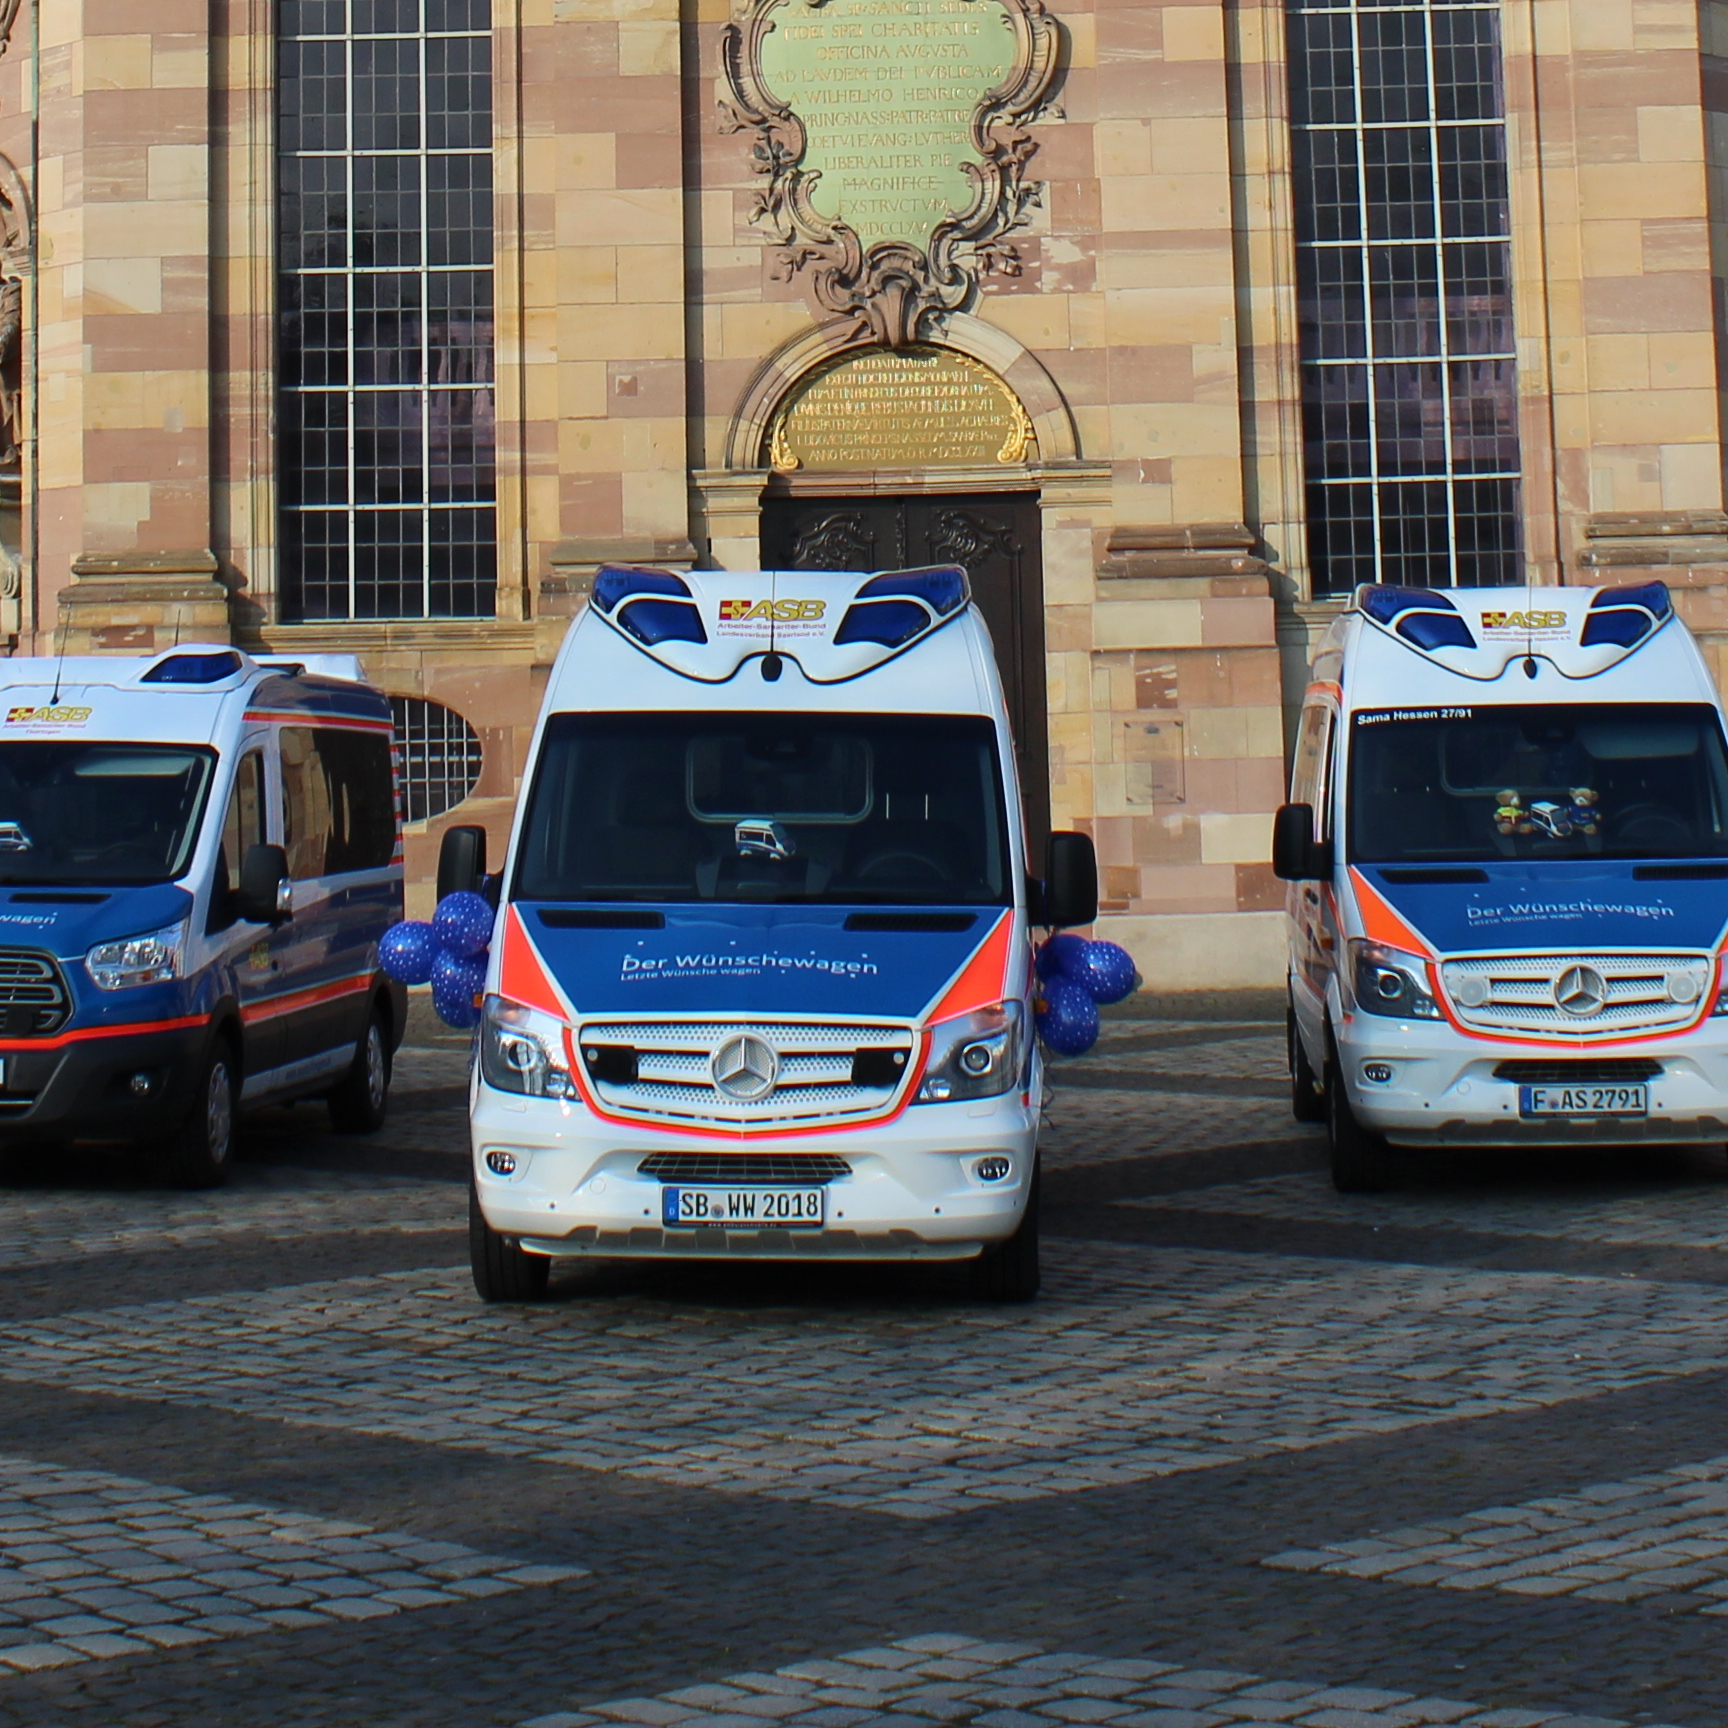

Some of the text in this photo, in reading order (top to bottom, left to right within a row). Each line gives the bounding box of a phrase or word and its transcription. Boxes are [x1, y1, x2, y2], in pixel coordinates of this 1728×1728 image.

[870, 1, 931, 15] SANCTI
[939, 0, 988, 14] SEDES
[832, 22, 864, 39] SPEI
[872, 20, 980, 39] CHARITATIS
[816, 43, 969, 61] OFFICINA AVGVSTA
[774, 64, 1002, 83] AD LAVDEM DEI PVBLICAM
[790, 86, 979, 106] A WILHELMO HENRICO
[824, 153, 953, 170] LIBERALITER PIE
[842, 175, 939, 191] MAGNIFICE
[838, 197, 948, 215] EXSTRVCTVM
[743, 599, 827, 622] ASB
[1502, 610, 1567, 629] ASB
[28, 705, 93, 722] ASB
[1357, 708, 1472, 726] Sama Hessen 27/91
[1467, 901, 1674, 919] Der Wünschewagen
[621, 953, 879, 975] Der Wünschewagen
[620, 967, 761, 981] Letzte Wünsche wagen
[1533, 1088, 1643, 1110] F AS 2791
[681, 1192, 818, 1218] SB WW 2018
